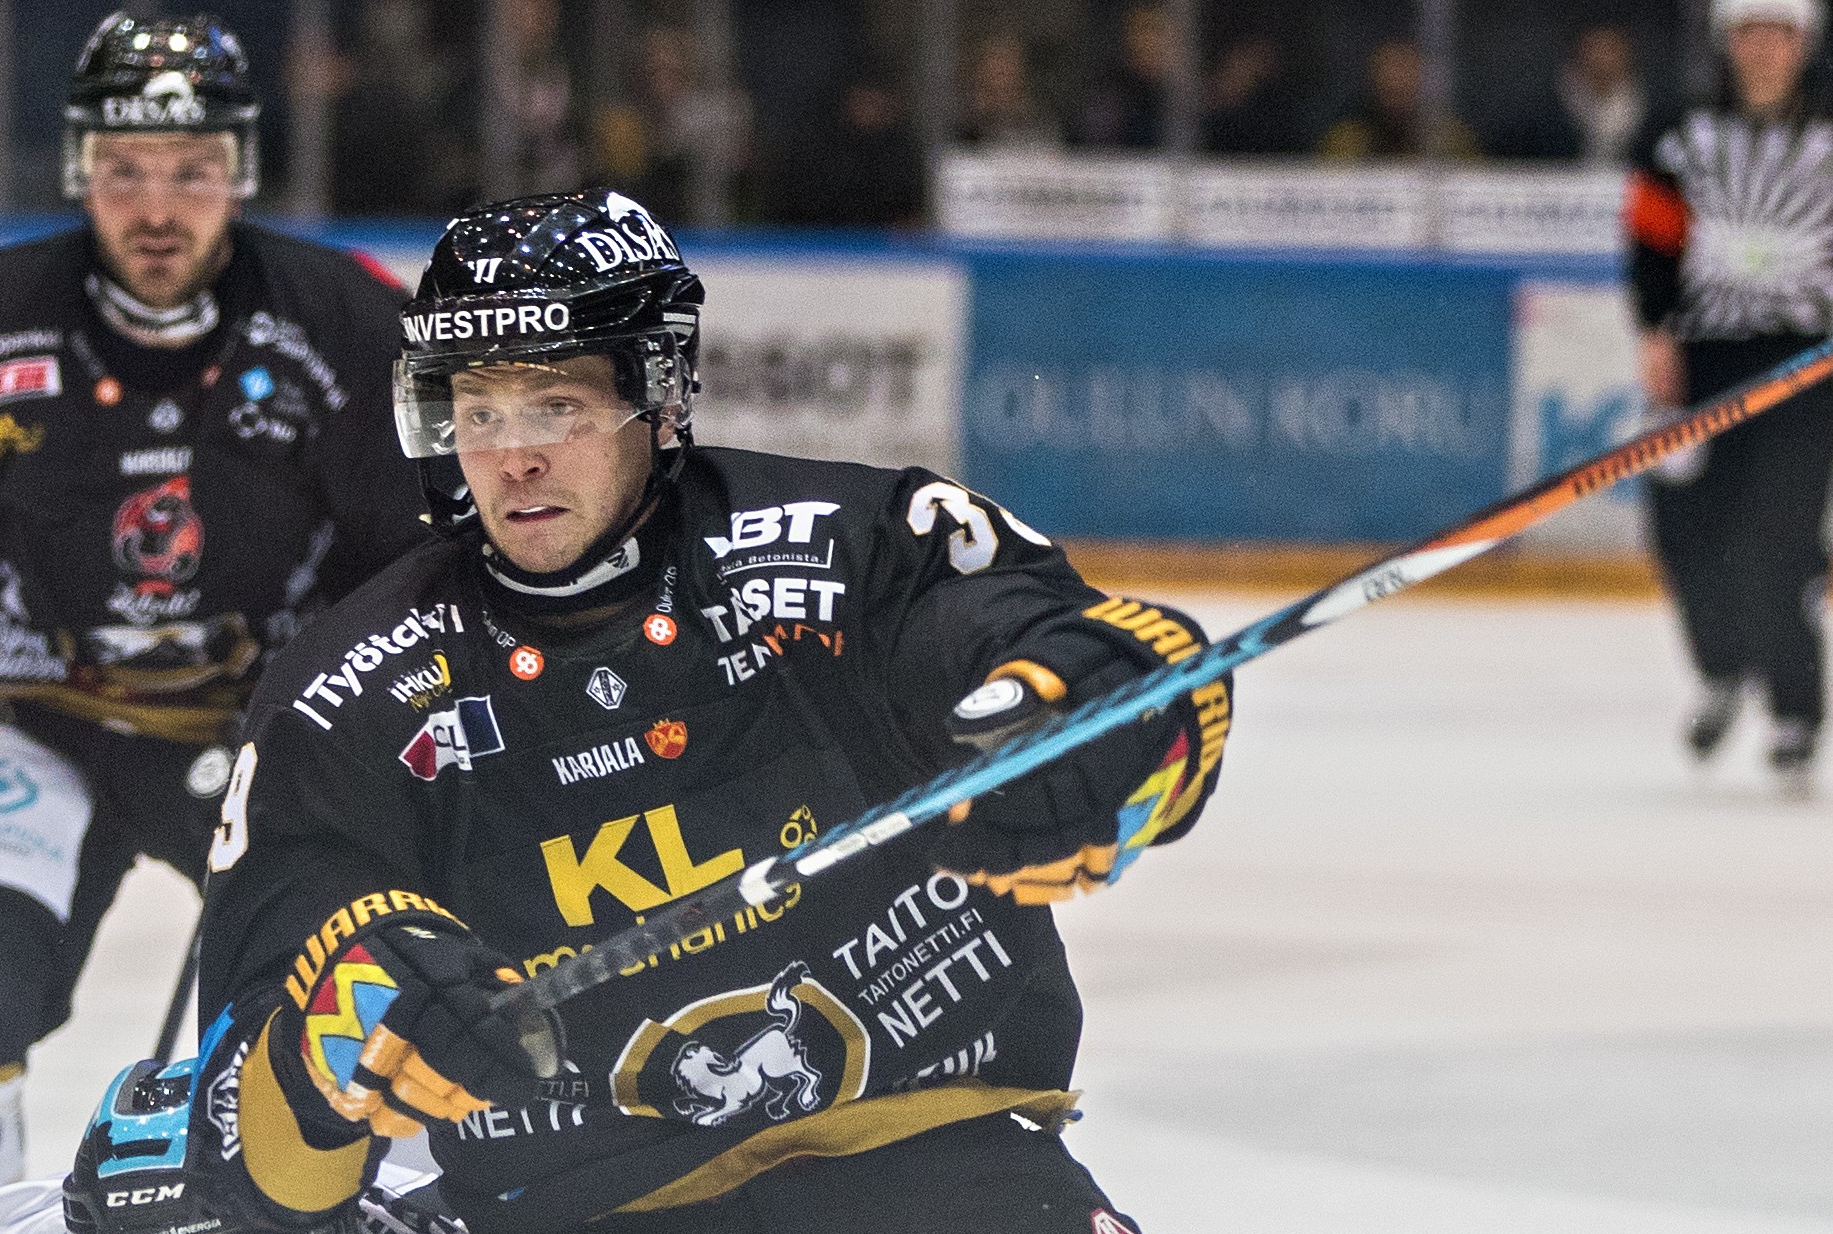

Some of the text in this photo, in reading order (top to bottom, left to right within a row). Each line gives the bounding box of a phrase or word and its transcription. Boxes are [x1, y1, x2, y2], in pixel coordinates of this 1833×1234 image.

[906, 481, 1053, 575] 3
[552, 736, 645, 785] KARJALA
[539, 803, 746, 928] KL
[832, 871, 969, 980] TAITO
[858, 908, 984, 1006] TAITONETTI.FI
[876, 929, 1013, 1049] NETTI
[105, 1183, 186, 1209] CCM
